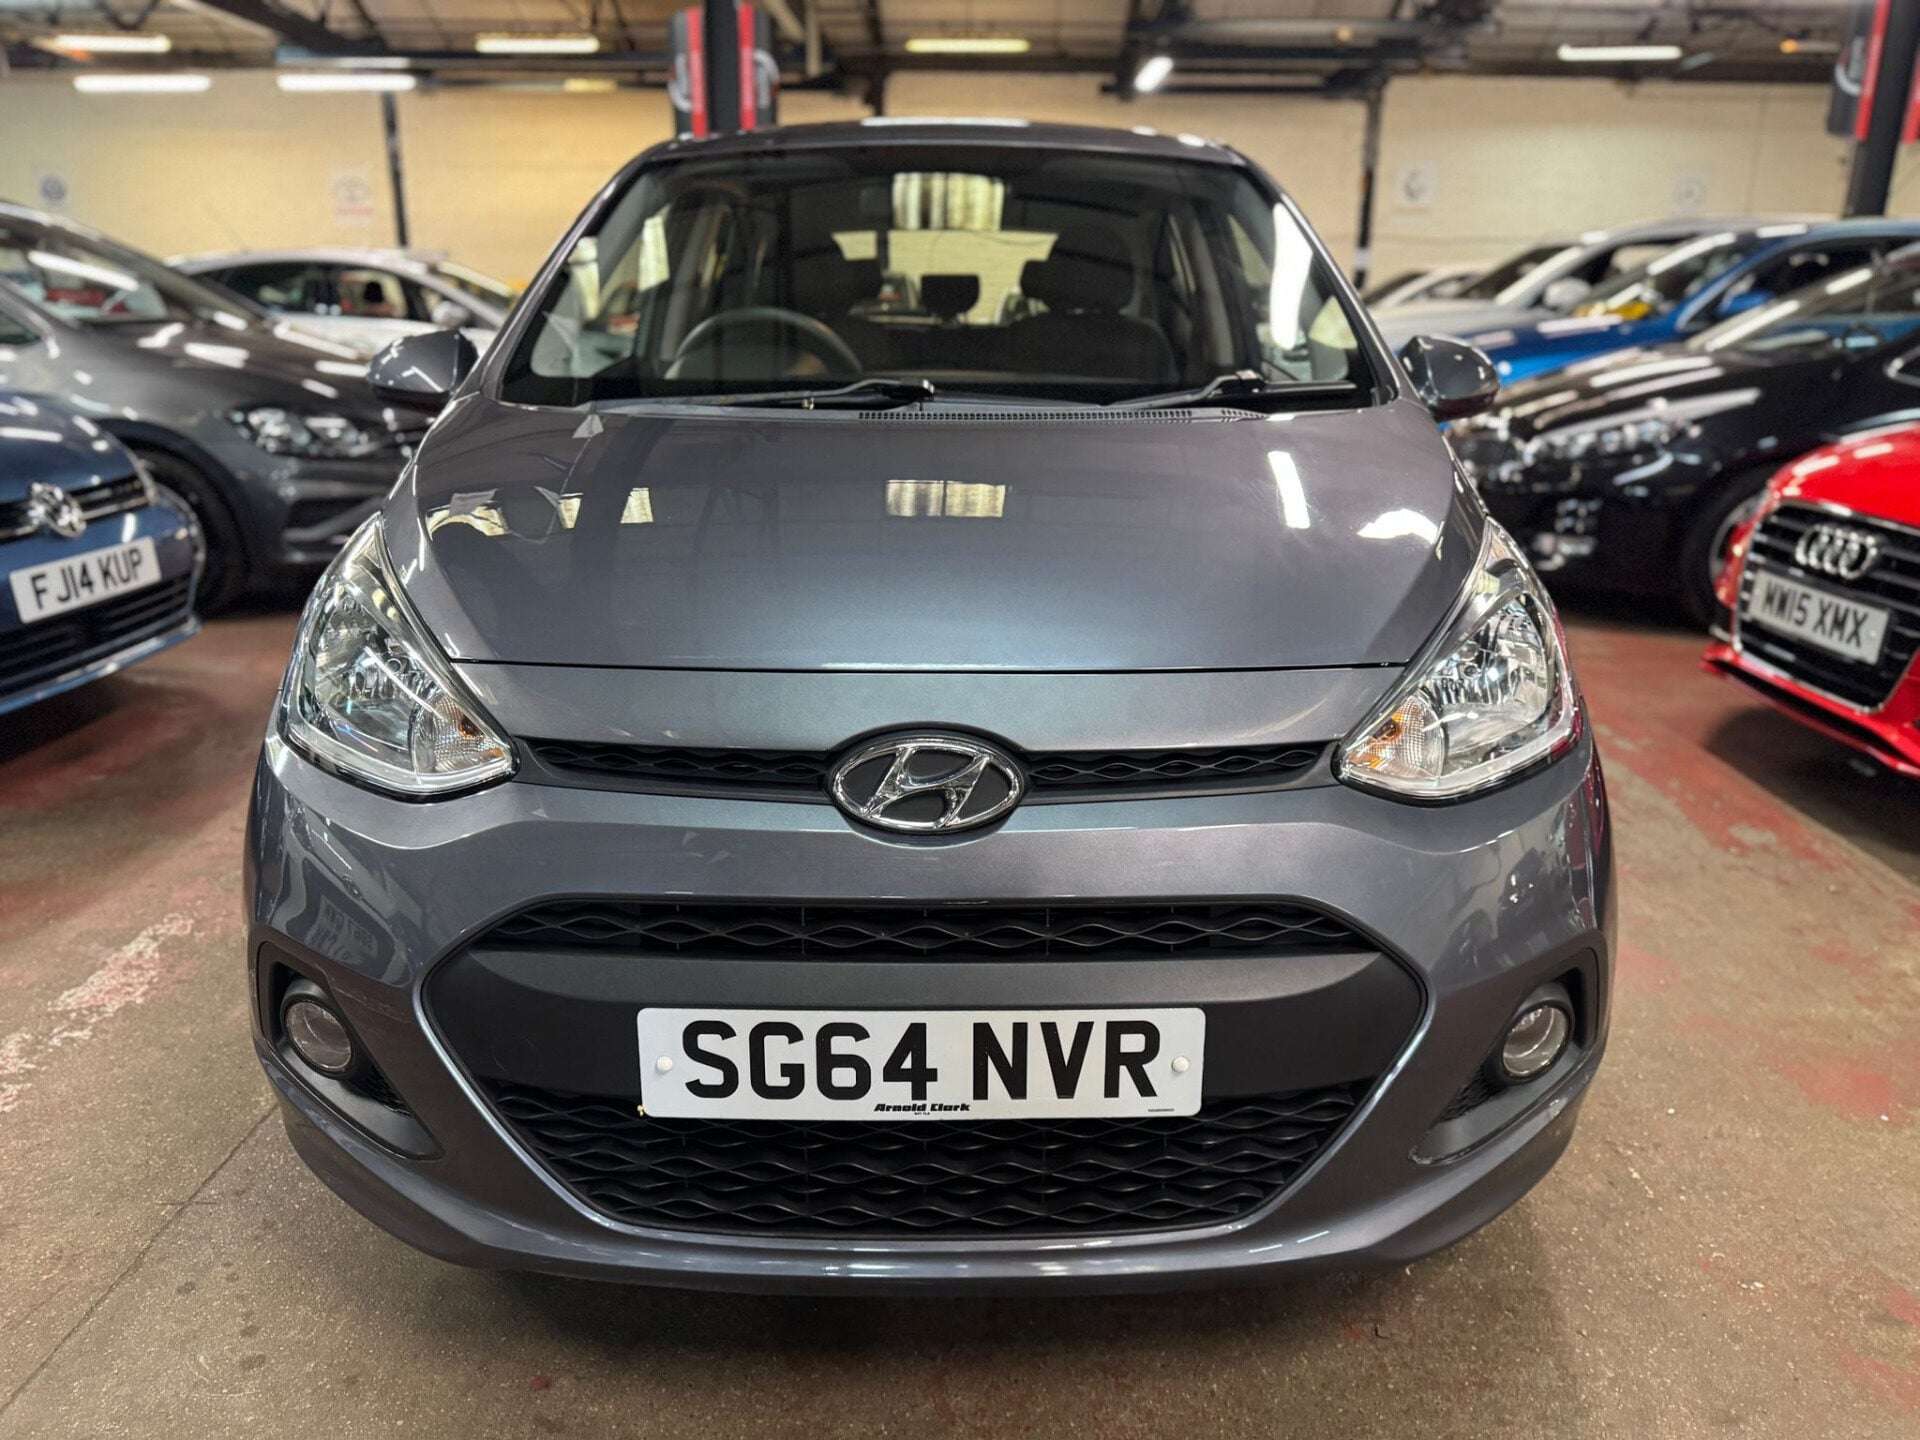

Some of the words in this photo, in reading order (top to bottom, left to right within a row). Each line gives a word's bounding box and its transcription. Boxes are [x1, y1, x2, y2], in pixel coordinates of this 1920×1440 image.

[31, 562, 93, 610] FJ14
[98, 549, 142, 589] KUP
[1813, 598, 1868, 647] XMX
[682, 1019, 938, 1101] SG64
[973, 1020, 1160, 1101] NVR
[874, 1103, 927, 1112] Arnold
[930, 1103, 970, 1112] Clark
